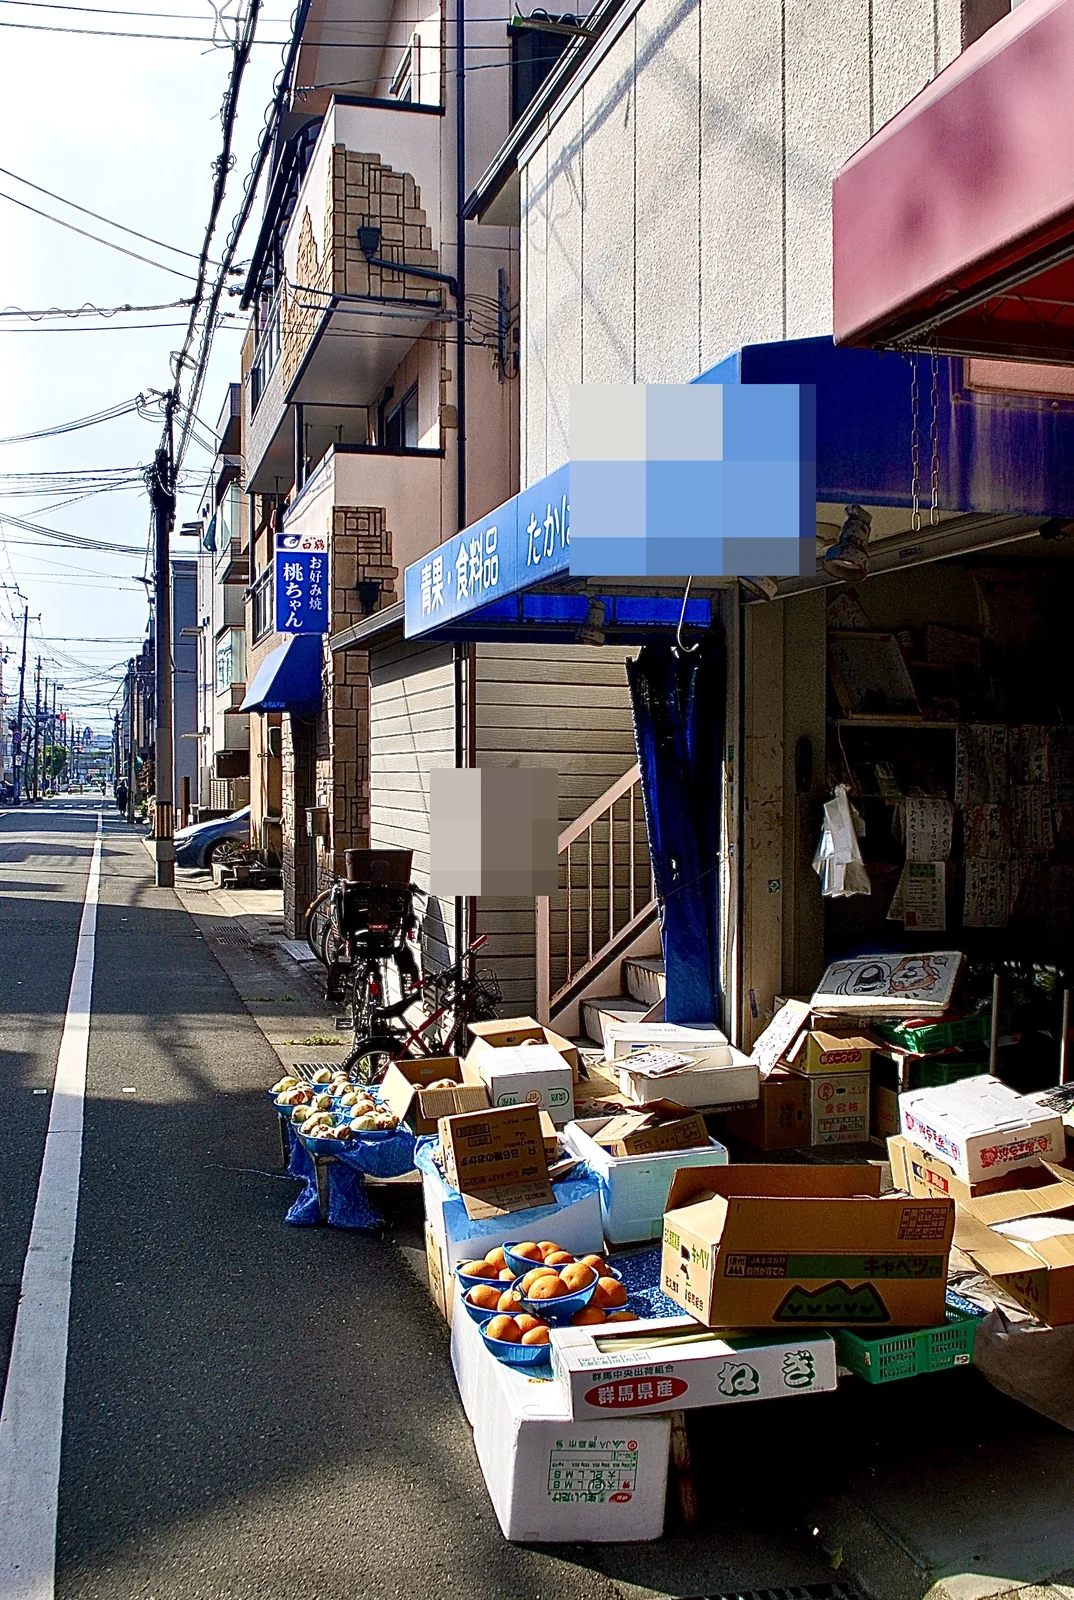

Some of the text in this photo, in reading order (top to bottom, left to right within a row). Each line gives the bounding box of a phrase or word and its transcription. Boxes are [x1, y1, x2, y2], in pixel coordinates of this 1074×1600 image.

[282, 562, 304, 628] 桃ちゃん
[592, 1364, 675, 1382] 群馬中央出荷組合
[718, 1350, 816, 1397] ねぎ
[598, 1379, 674, 1405] 群馬県産
